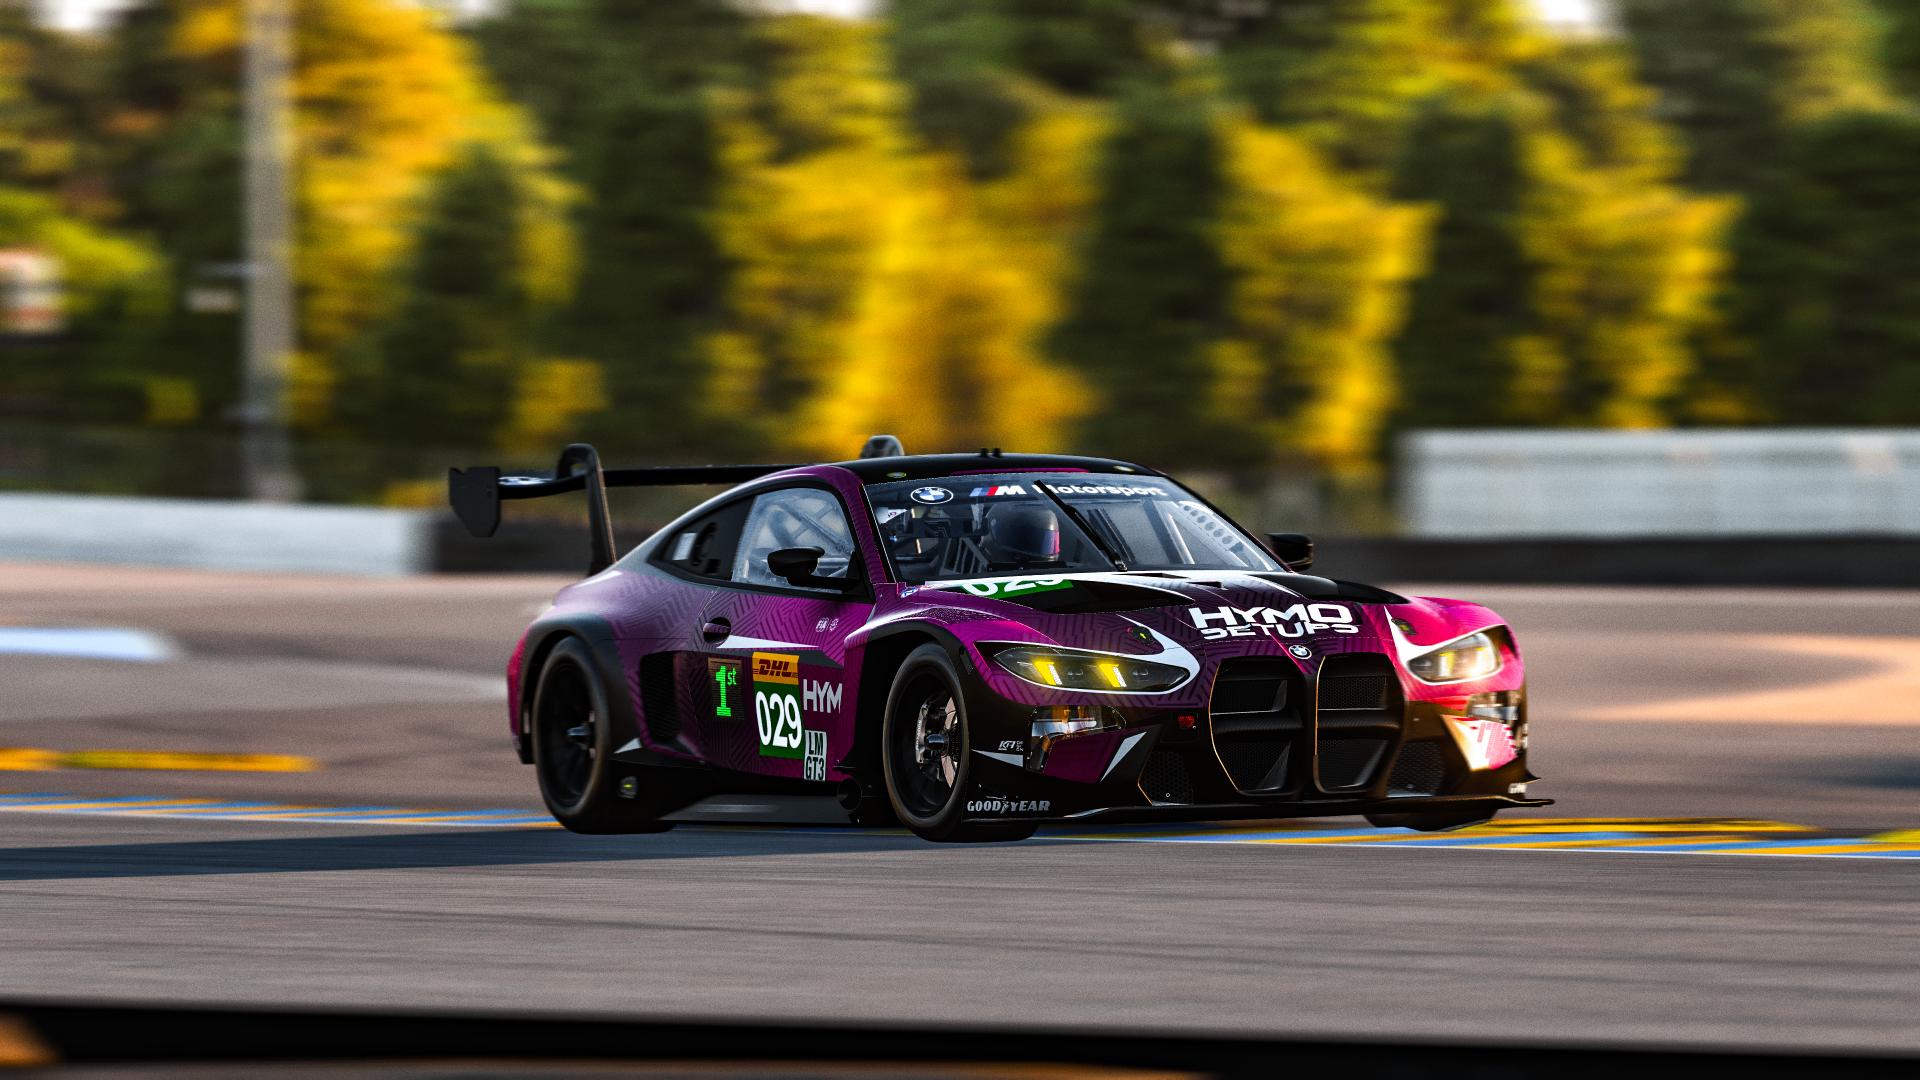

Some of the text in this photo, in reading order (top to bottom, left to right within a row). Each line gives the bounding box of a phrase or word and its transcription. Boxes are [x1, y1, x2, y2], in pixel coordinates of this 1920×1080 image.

[994, 485, 1028, 496] M
[1187, 603, 1353, 629] HYMO
[1200, 621, 1359, 640] SETUPS
[758, 659, 793, 678] DHL
[755, 691, 802, 749] 029
[808, 732, 824, 756] LM
[806, 756, 825, 781] GT3
[967, 800, 1051, 812] GOODYEAR
